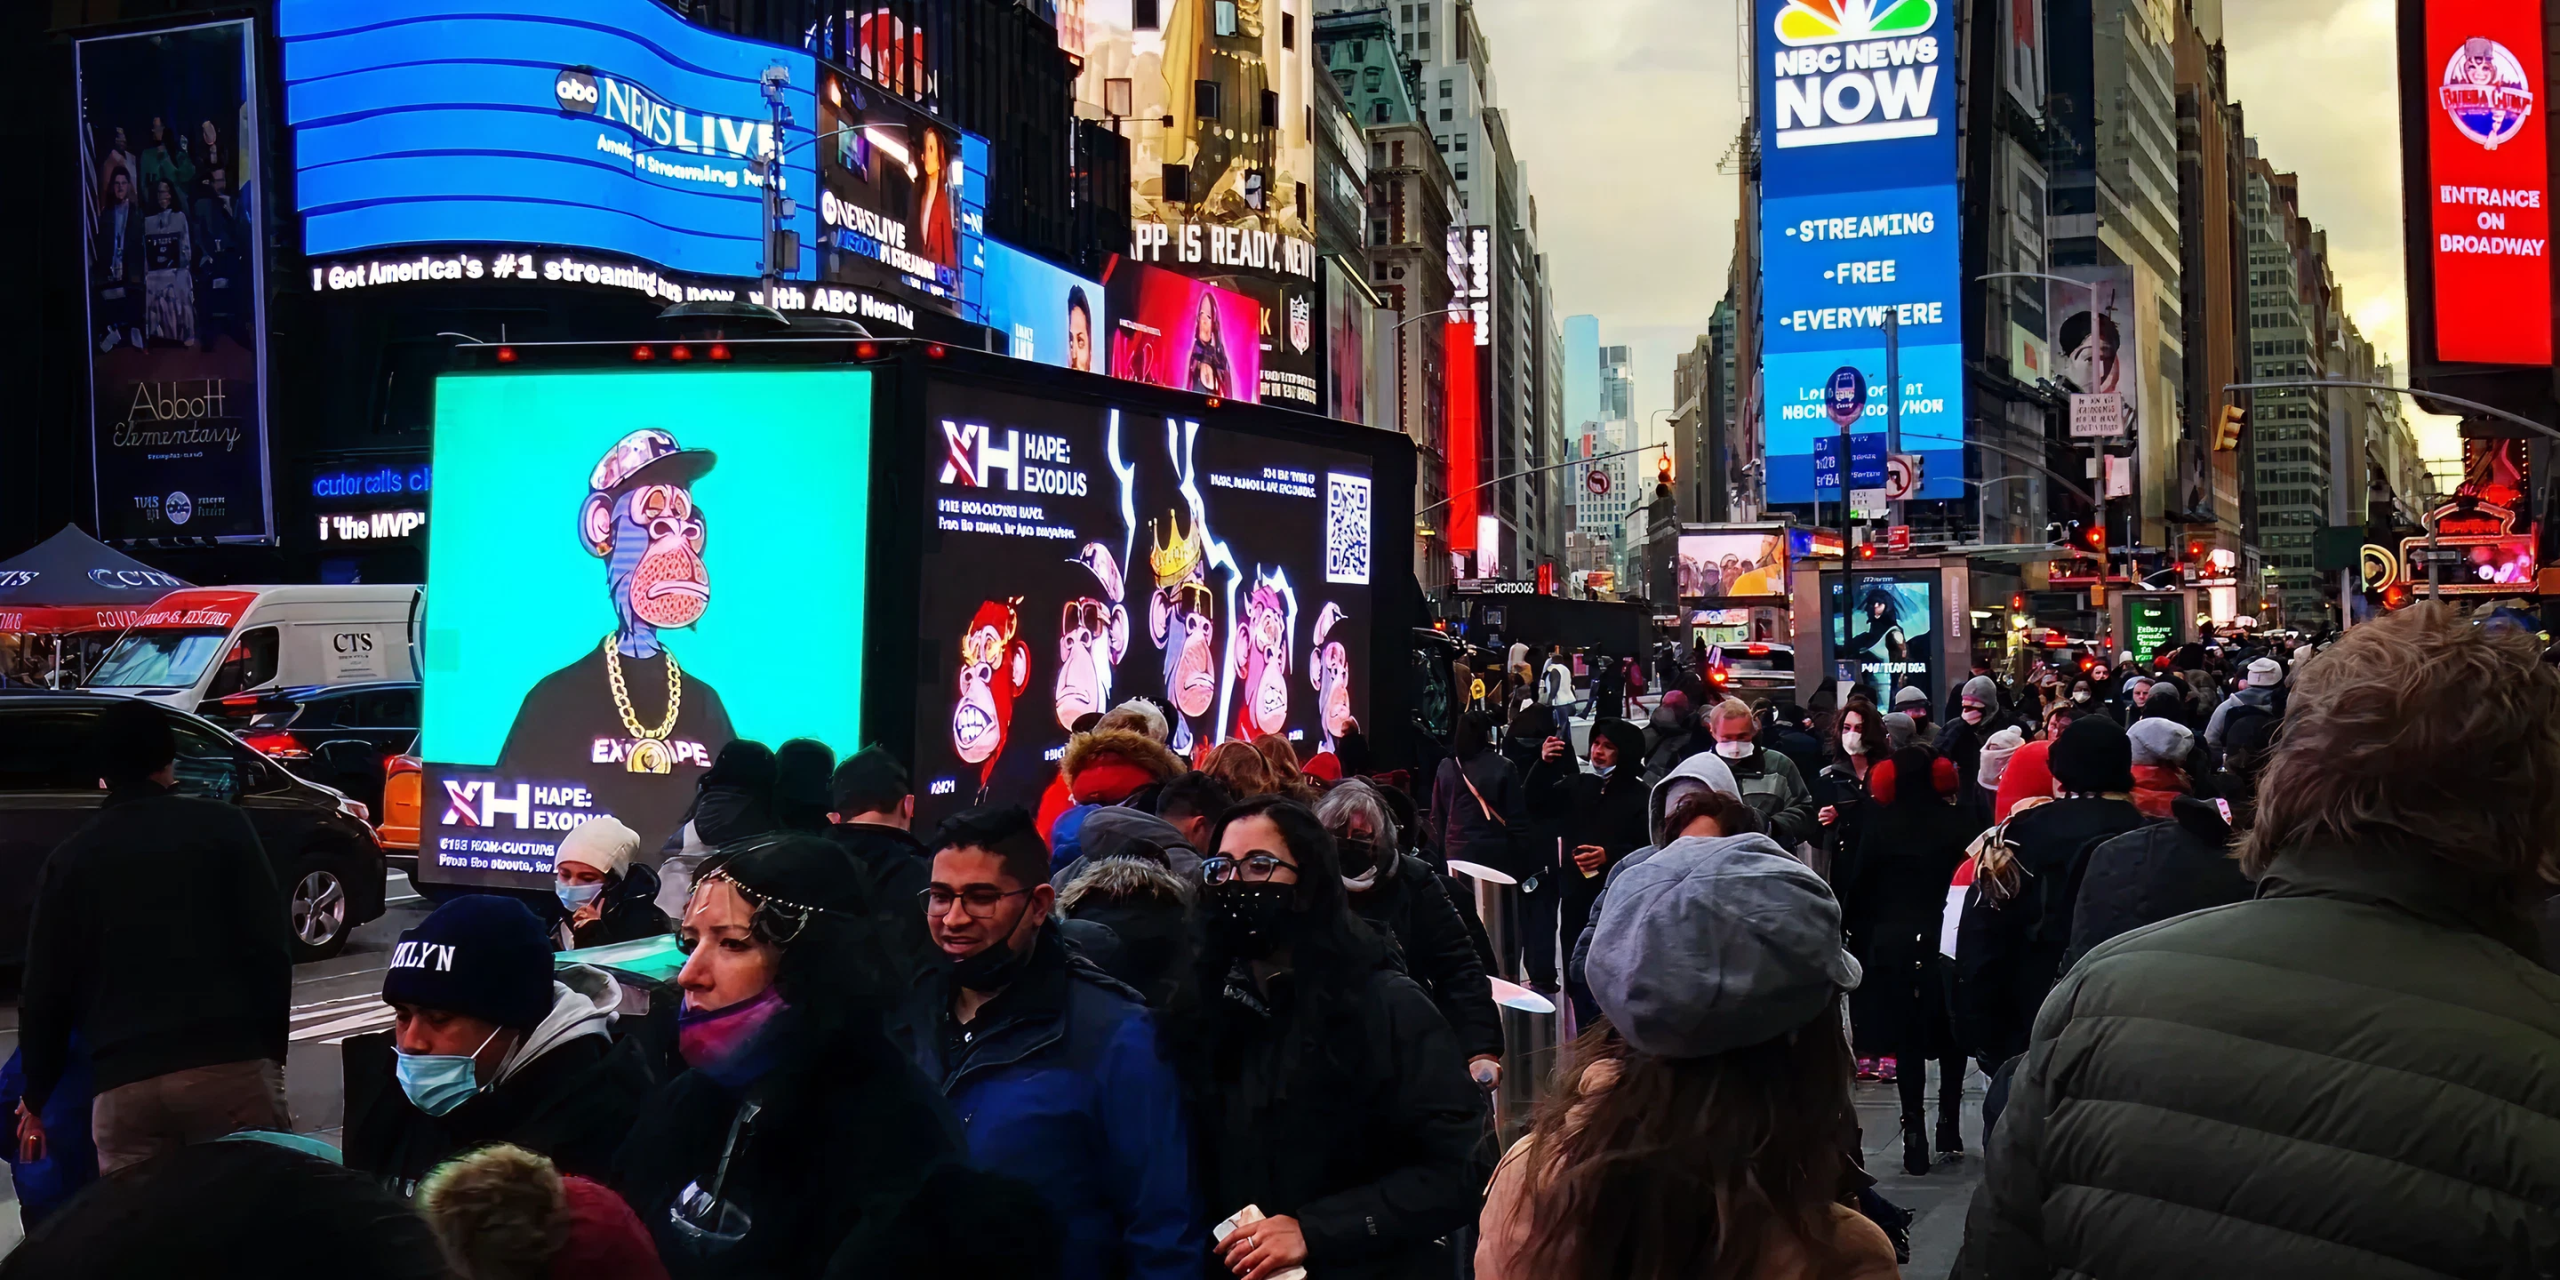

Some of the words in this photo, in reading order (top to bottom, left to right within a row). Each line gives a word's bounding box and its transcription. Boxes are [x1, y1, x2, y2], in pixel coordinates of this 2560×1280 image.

[1775, 46, 1841, 77] NBC
[1845, 36, 1939, 70] NEWS
[604, 77, 672, 146] NEWS
[1775, 65, 1939, 129] NOW
[2440, 185, 2541, 208] ENTRANCE
[1799, 211, 1934, 242] STREAMING
[2477, 211, 2505, 230] ON
[1178, 224, 1202, 263] IS
[1210, 225, 1280, 274] READY,
[2440, 234, 2545, 256] BROADWAY
[328, 266, 366, 290] Got
[368, 254, 484, 286] America's
[492, 254, 537, 280] #1
[811, 288, 857, 315] ABC
[1837, 260, 1896, 285] FREE
[1793, 302, 1943, 332] EVERYWERE
[128, 378, 226, 422] Abbott
[113, 420, 242, 452] Elementary
[1025, 433, 1071, 464] HAPE:
[364, 468, 402, 493] calls
[1024, 466, 1088, 497] EXODUS
[333, 632, 373, 653] CTS
[534, 786, 593, 808] HAPE:
